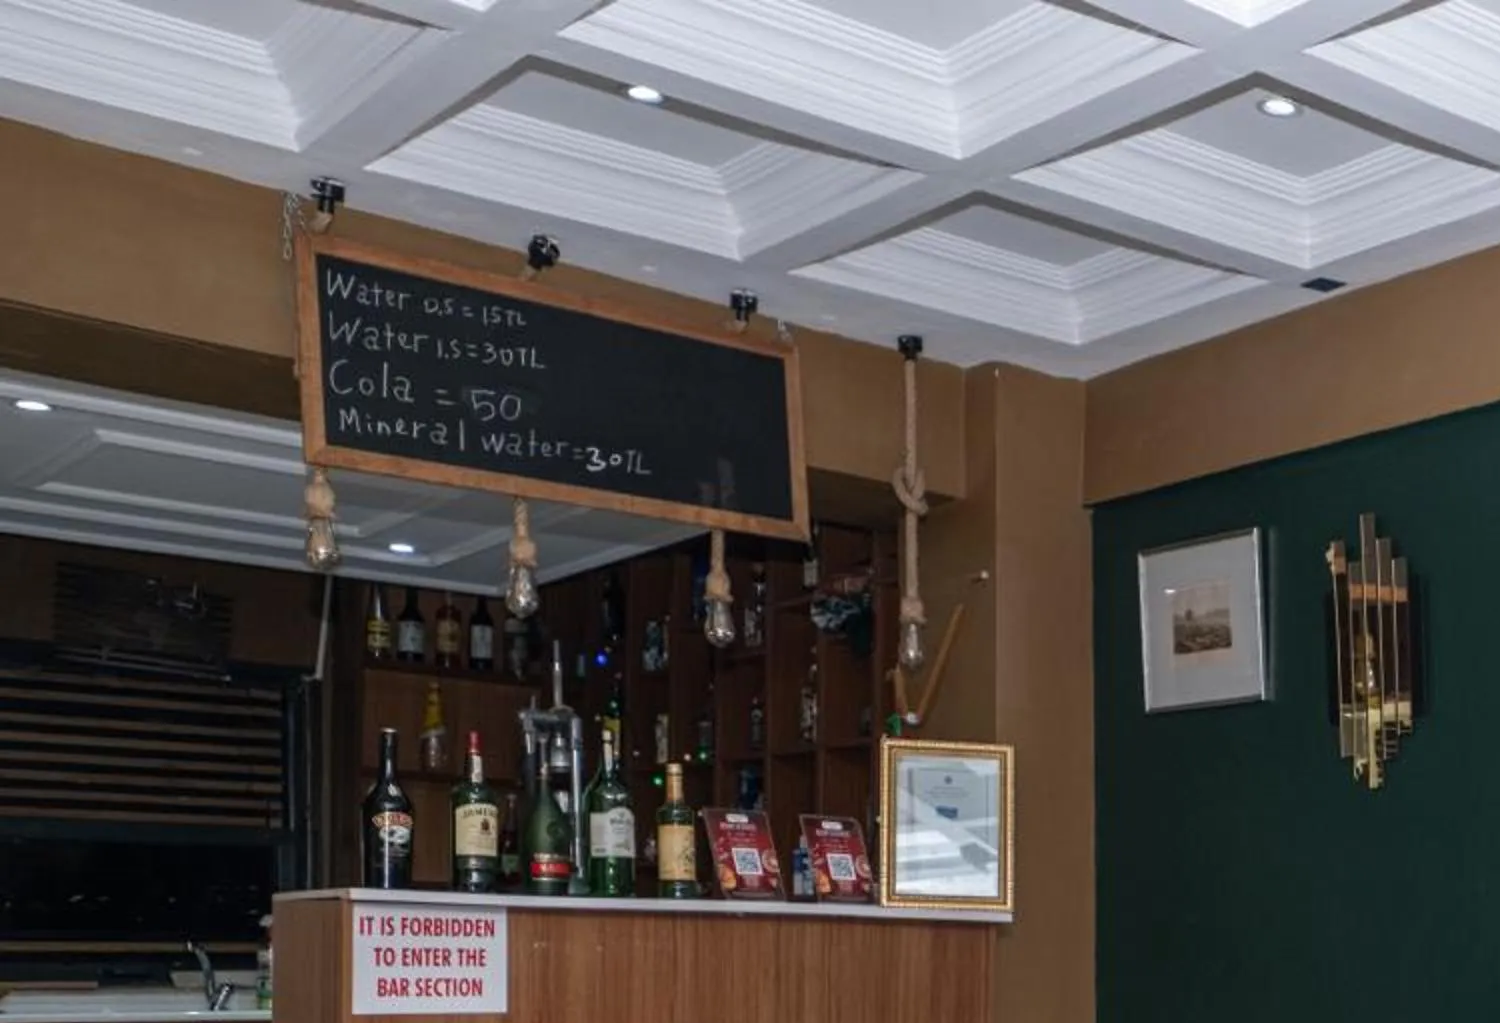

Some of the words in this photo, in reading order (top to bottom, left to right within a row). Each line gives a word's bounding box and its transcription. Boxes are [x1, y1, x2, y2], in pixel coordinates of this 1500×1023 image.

[327, 268, 411, 311] Water
[423, 298, 455, 317] 0.5
[328, 311, 430, 352] Water
[328, 358, 415, 403] Cola
[471, 388, 522, 422] 50
[338, 407, 465, 451] Mineral
[359, 915, 374, 936] IT
[380, 916, 395, 937] IS
[401, 917, 496, 938] FORBIDDEN
[374, 947, 396, 967] TO
[401, 947, 452, 968] ENTER
[458, 948, 488, 968] THE
[377, 977, 410, 998] BAR
[415, 977, 484, 998] SECTION
